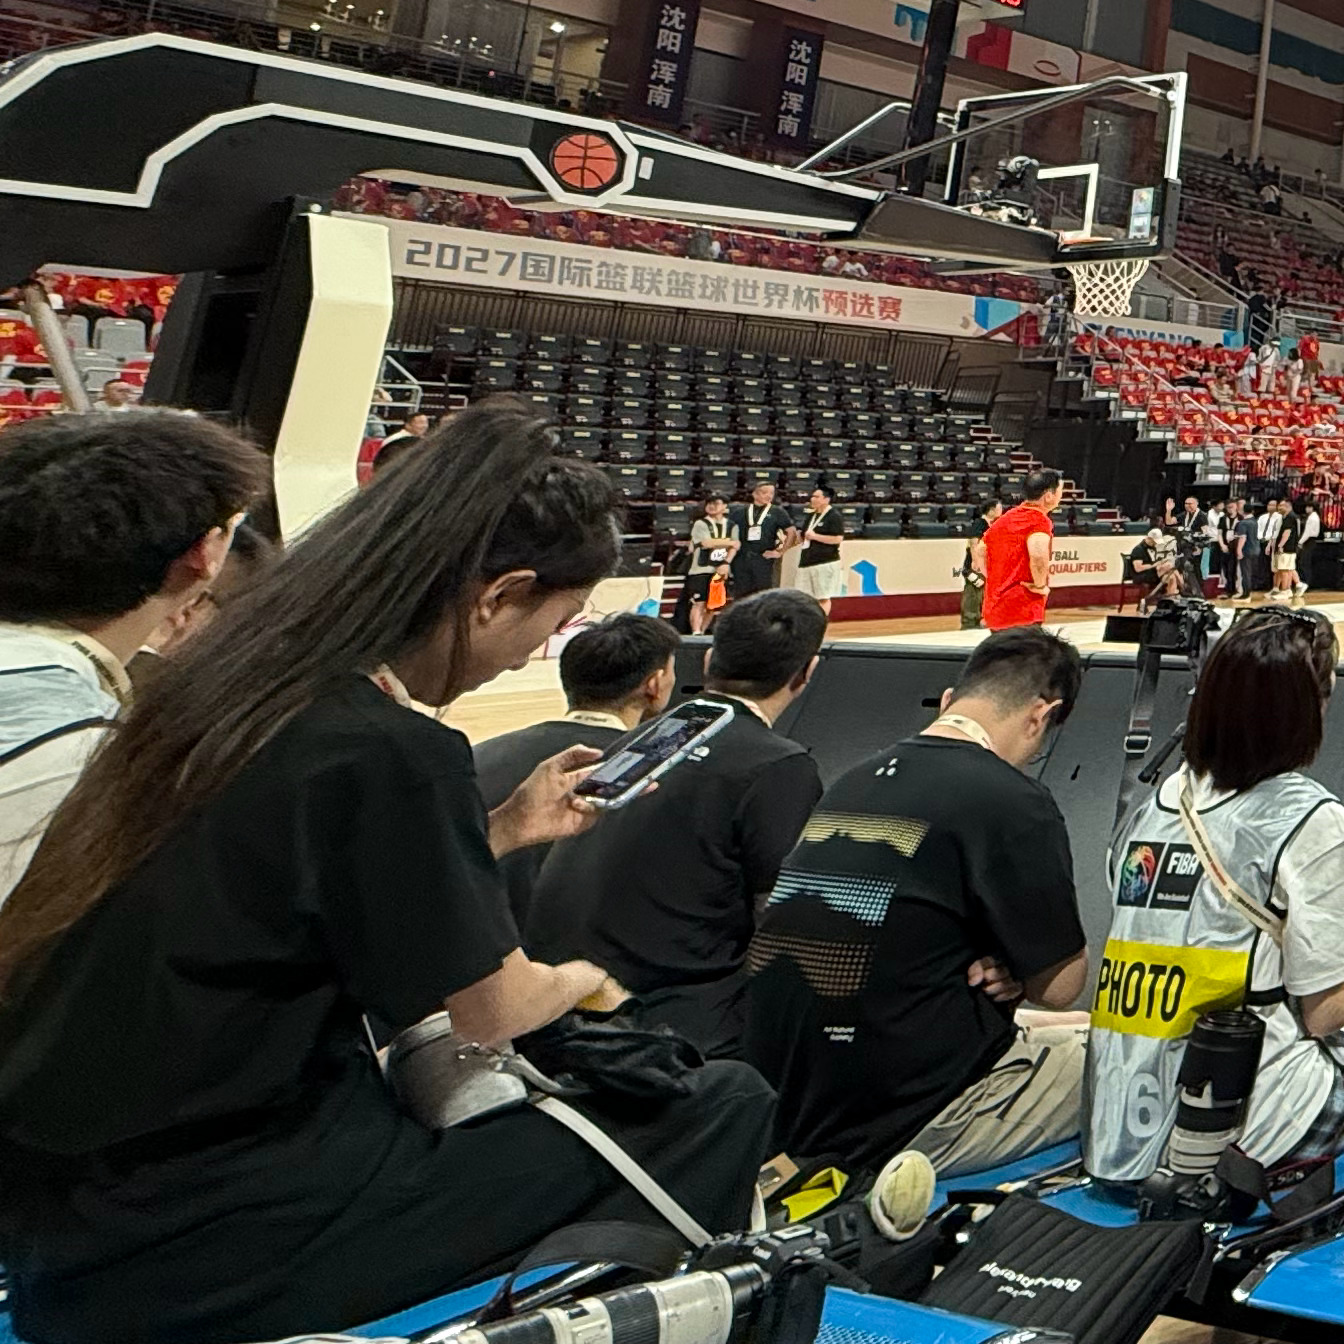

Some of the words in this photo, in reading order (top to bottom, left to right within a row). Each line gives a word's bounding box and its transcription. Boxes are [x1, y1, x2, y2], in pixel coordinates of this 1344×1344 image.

[405, 238, 903, 324] 2027国际篮联篮球世界杯预选赛
[1050, 562, 1107, 575] QUALIFIERS
[1167, 852, 1199, 875] FIBA
[1094, 957, 1187, 1023] PHOTO
